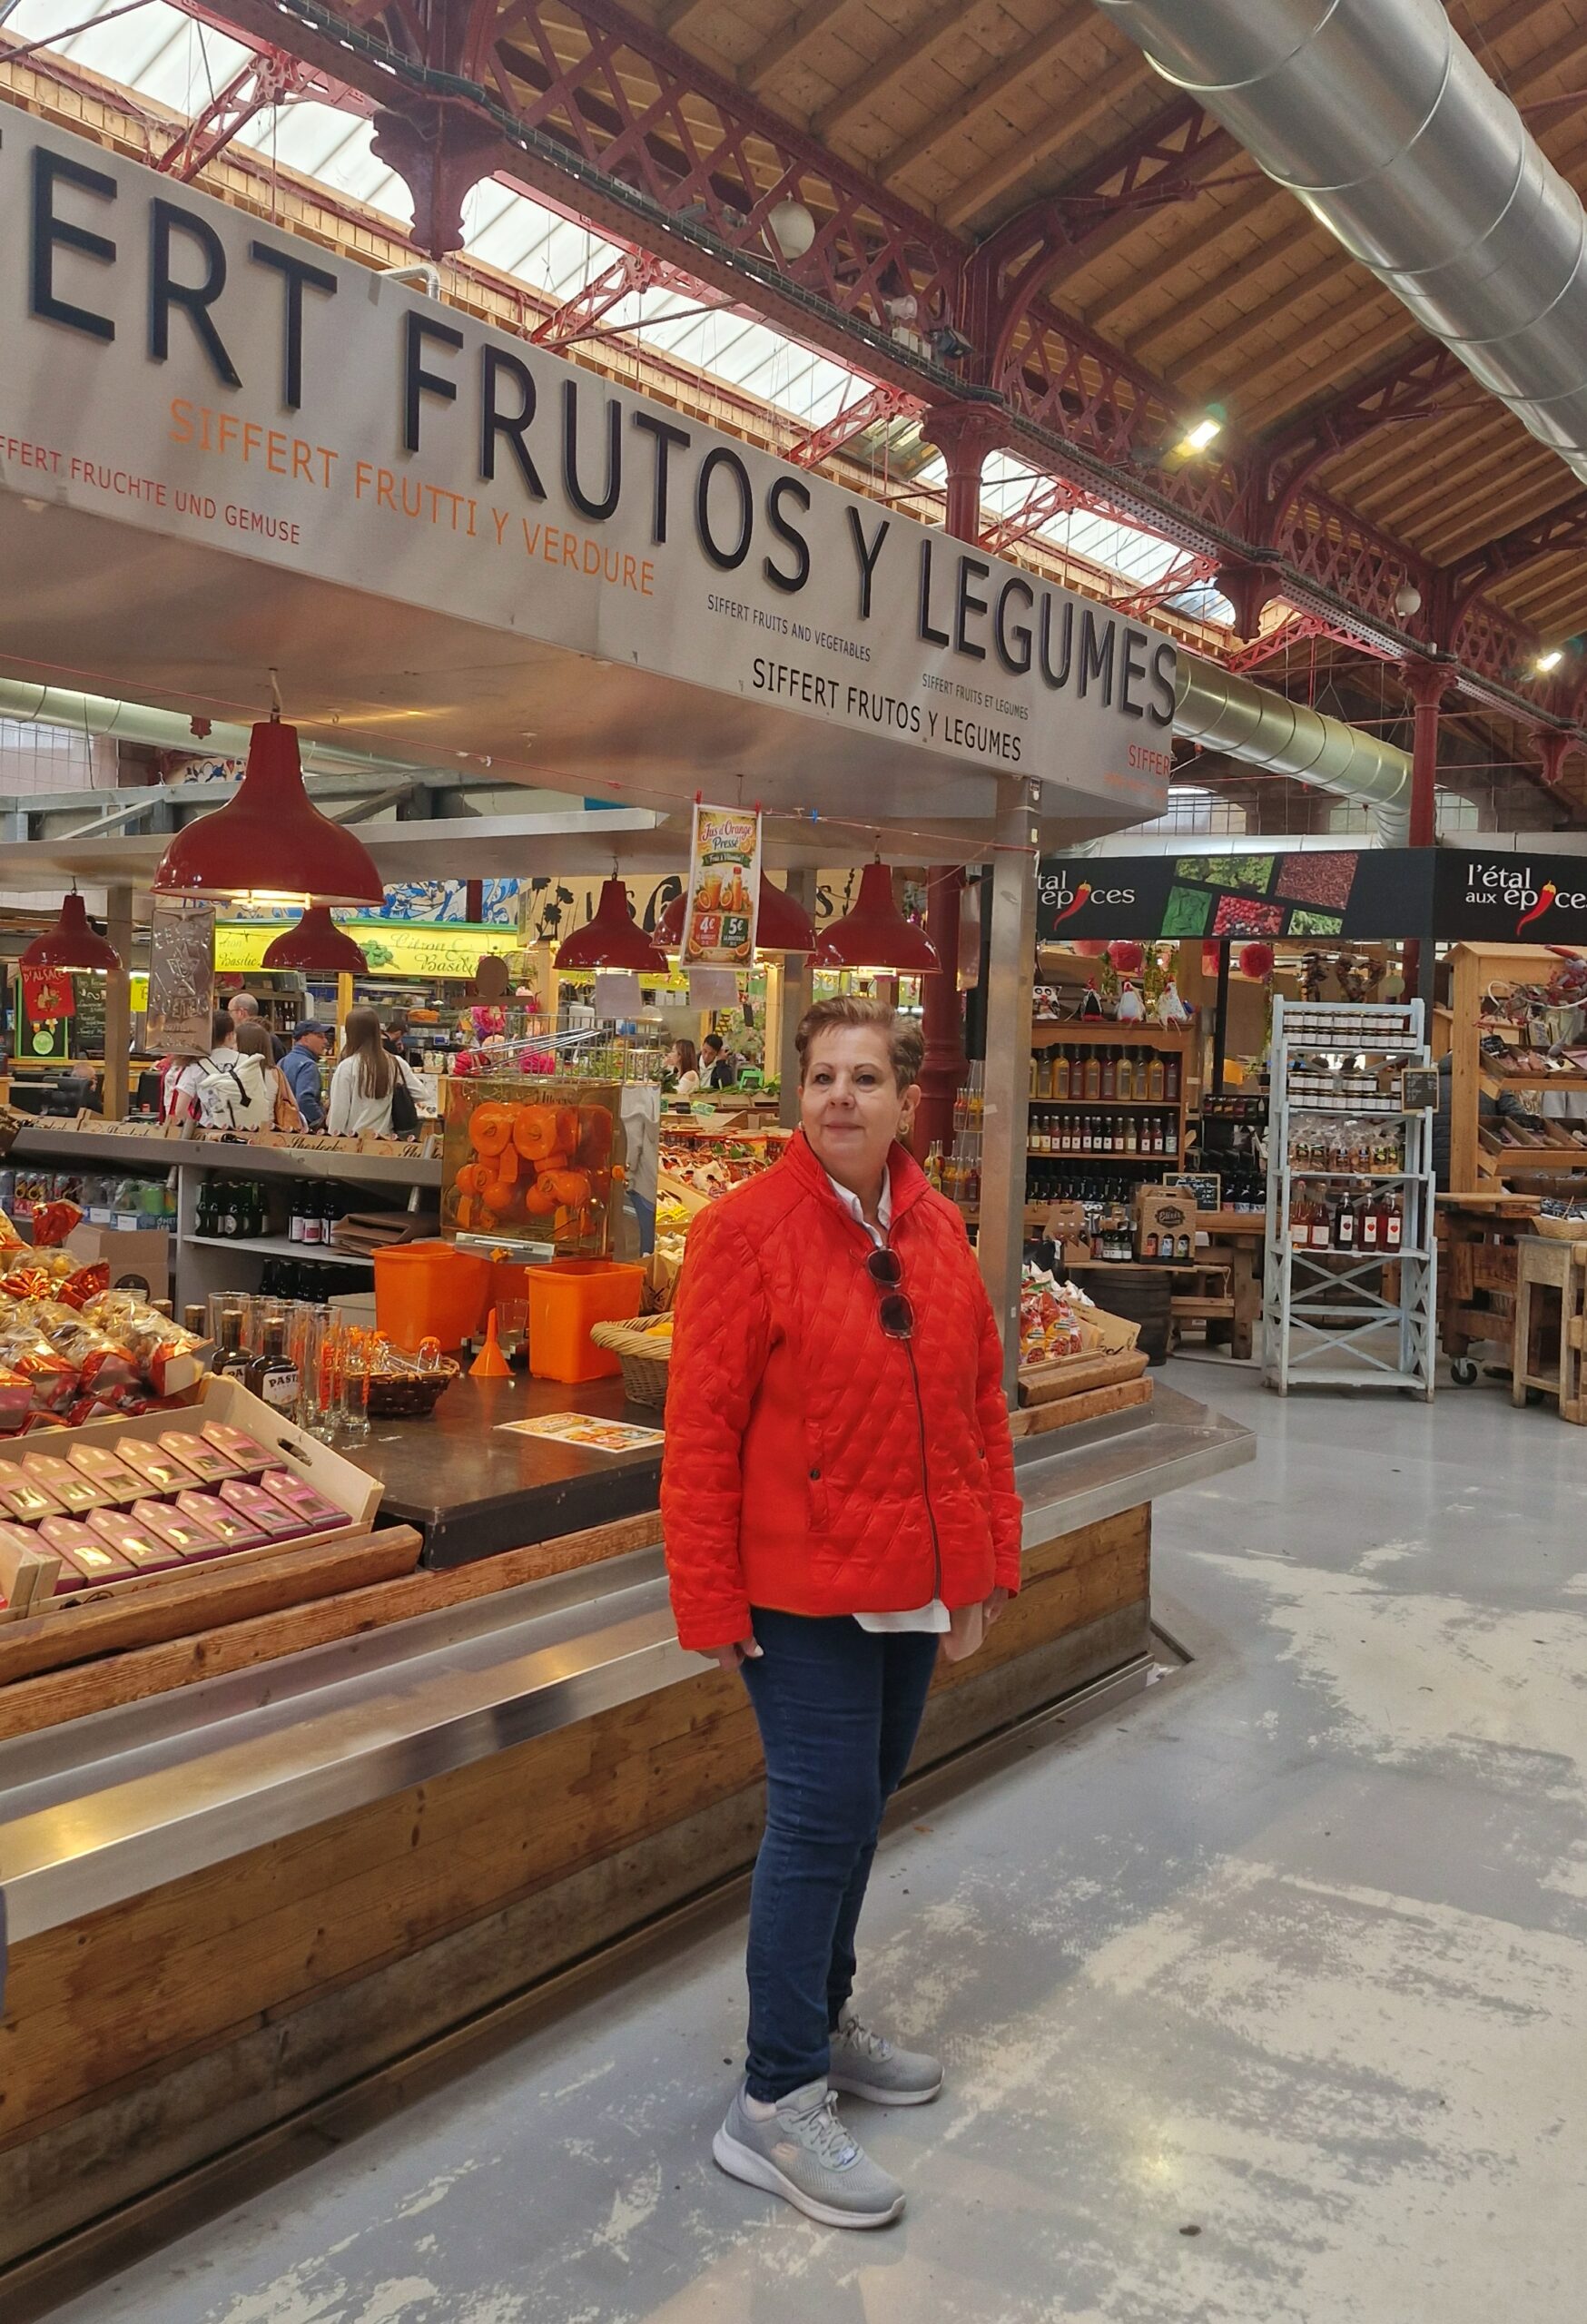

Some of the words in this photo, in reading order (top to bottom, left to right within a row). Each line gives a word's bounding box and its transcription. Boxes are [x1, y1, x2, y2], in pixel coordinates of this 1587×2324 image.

[0, 128, 338, 410] ERT
[404, 309, 811, 593] FRUTOS
[847, 505, 891, 619] Y
[919, 538, 1178, 727] LEGUMES
[70, 457, 167, 507] FRUCHTE
[174, 488, 217, 520] UND
[224, 504, 301, 545] GEMUSE
[169, 398, 339, 489] SIFFERT
[355, 460, 478, 537] FRUTTI
[491, 507, 509, 546] Y
[522, 517, 655, 596] VERDURE
[707, 594, 751, 622] SIFFERT
[753, 609, 789, 635] FRUITS
[791, 624, 812, 643] AND
[814, 630, 872, 663] VEGETABLES
[752, 658, 840, 710] SIFFERT
[846, 685, 922, 734] FRUTOS
[928, 710, 939, 737] Y
[944, 715, 1022, 762] LEGUMES
[922, 673, 955, 696] SIFFERT
[955, 684, 983, 707] FRUITS
[984, 694, 995, 708] ET
[995, 698, 1030, 721] LEGUMES
[701, 822, 718, 842] Jus
[712, 836, 740, 852] Pressé
[1467, 863, 1531, 889] l'étal
[1465, 891, 1497, 904] aux
[1503, 882, 1587, 919] épice
[699, 915, 715, 934] 4€
[729, 917, 744, 935] 5€
[390, 931, 446, 952] Citron
[414, 952, 478, 973] Basili
